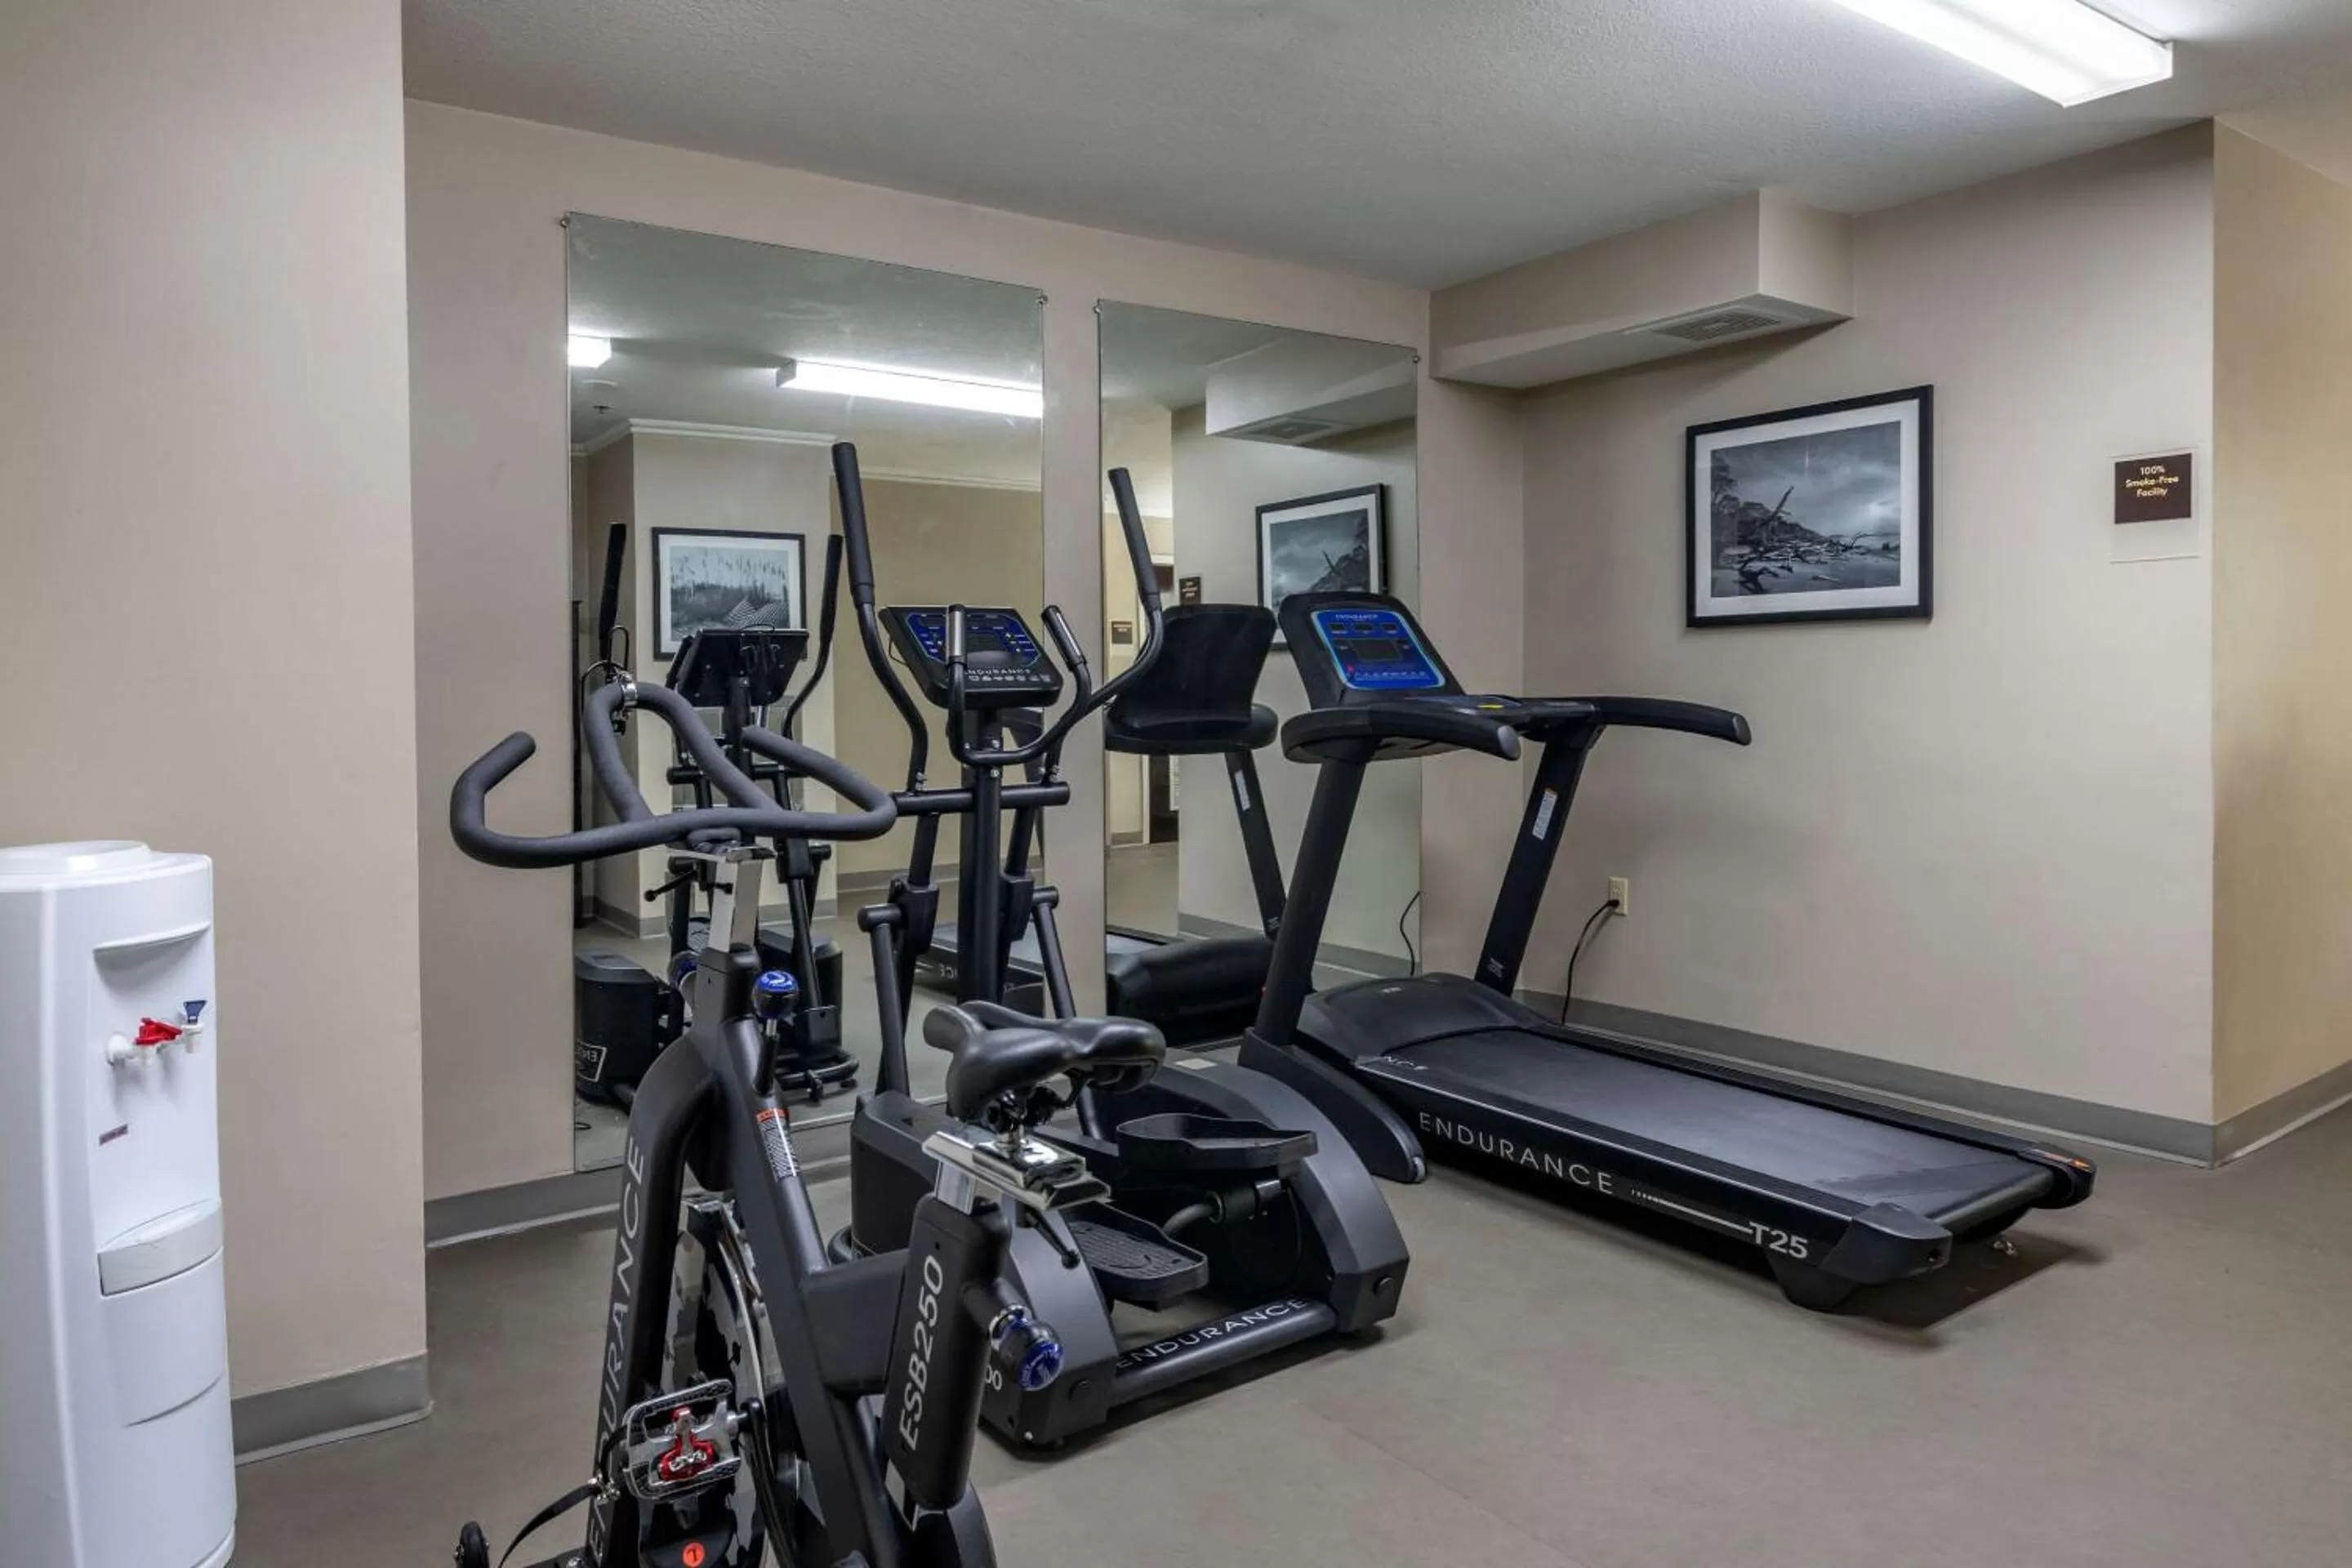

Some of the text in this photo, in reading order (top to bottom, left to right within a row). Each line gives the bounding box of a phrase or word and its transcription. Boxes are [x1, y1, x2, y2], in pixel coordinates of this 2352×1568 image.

[2125, 475, 2180, 488] Smoke-Free
[2140, 465, 2166, 475] 100%
[2136, 487, 2168, 497] Facility
[1419, 1111, 1808, 1258] ENDURANCE T25
[899, 1254, 943, 1450] ESB250
[1116, 1297, 1307, 1369] ENDURANCE
